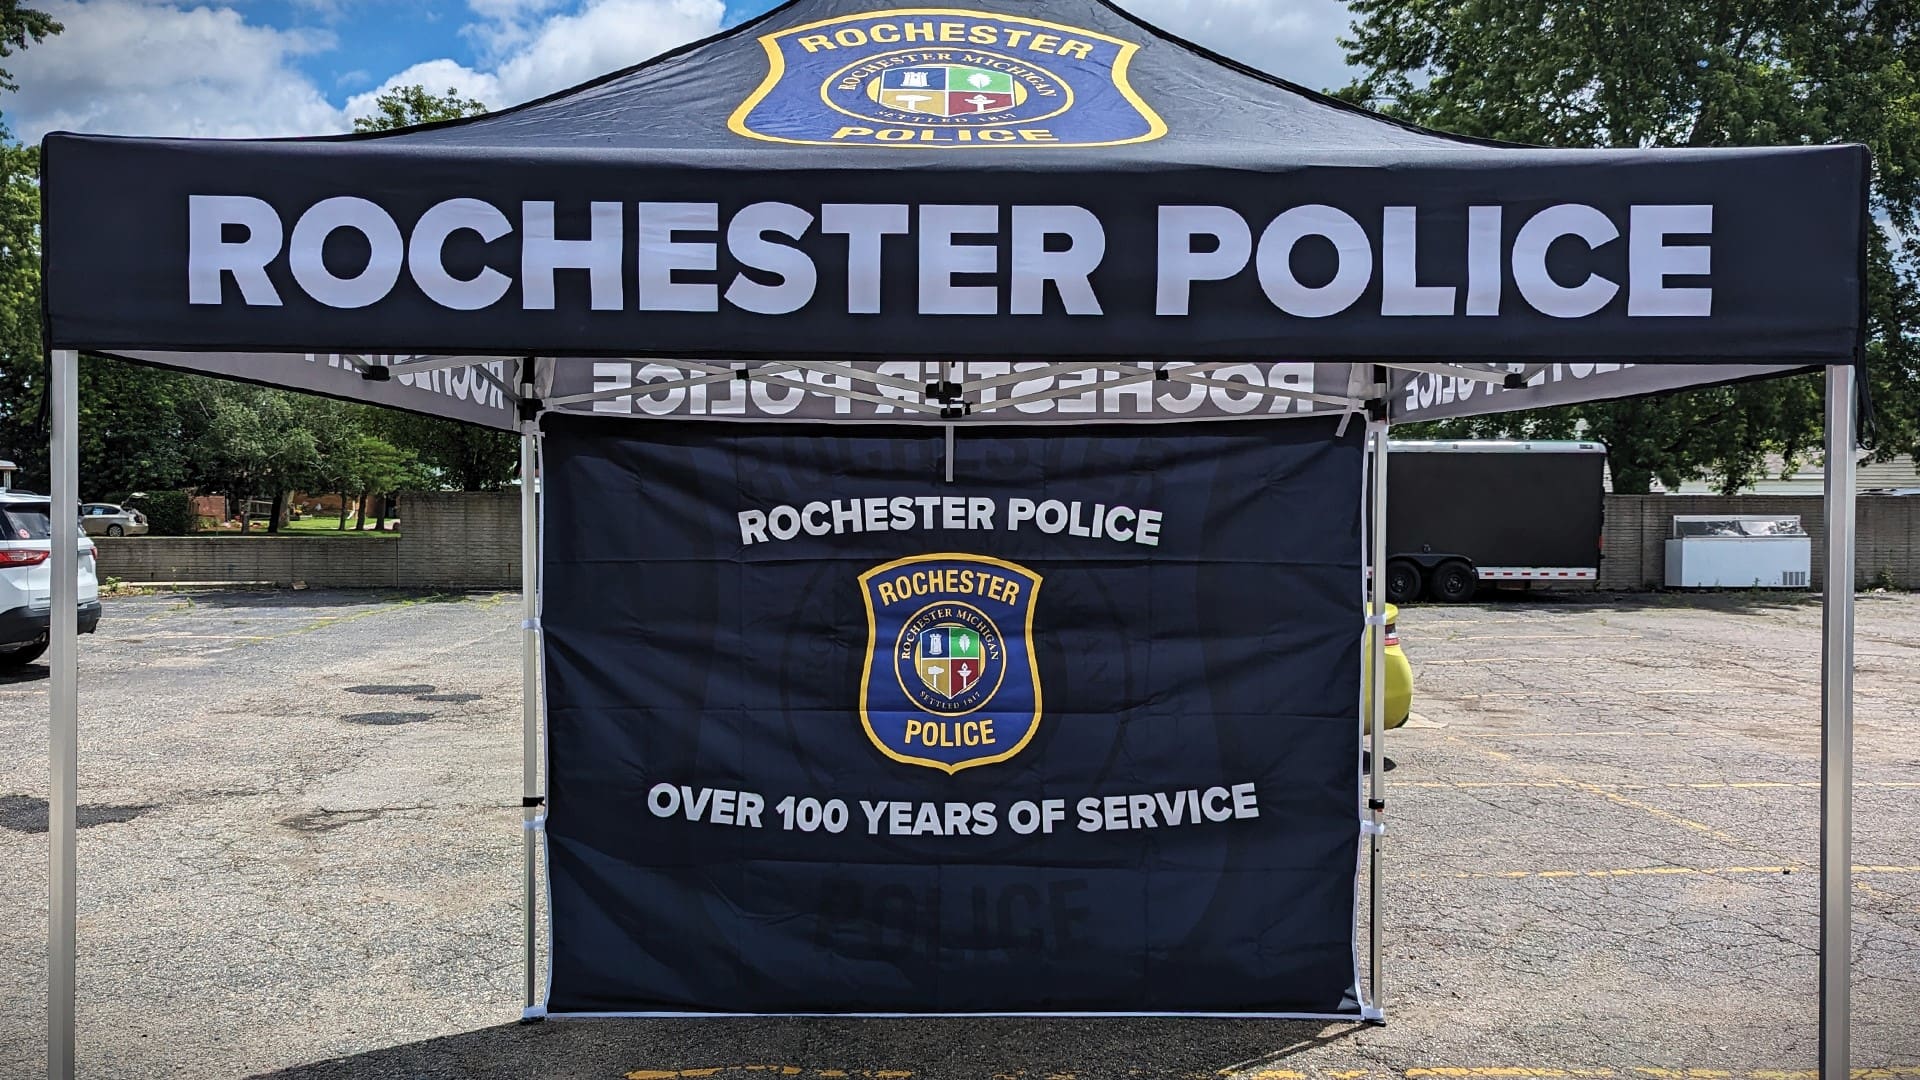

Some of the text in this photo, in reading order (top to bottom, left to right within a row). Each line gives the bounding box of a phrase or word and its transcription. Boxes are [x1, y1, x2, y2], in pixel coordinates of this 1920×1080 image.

[797, 21, 1094, 61] ROCHESTER
[838, 53, 1058, 97] ROCHESTER MICHIGAN
[831, 126, 1060, 142] POLICE
[188, 194, 1714, 318] ROCHESTER POLICE
[737, 496, 1163, 546] ROCHESTER POLICE
[878, 569, 1020, 606] ROCHESTER
[901, 608, 999, 660] ROCHESTER MICHIGAN
[920, 690, 980, 709] SETTLED 1817
[904, 719, 996, 747] POLICE
[647, 782, 1260, 836] OVER 100 YEARS OF SERVICE
